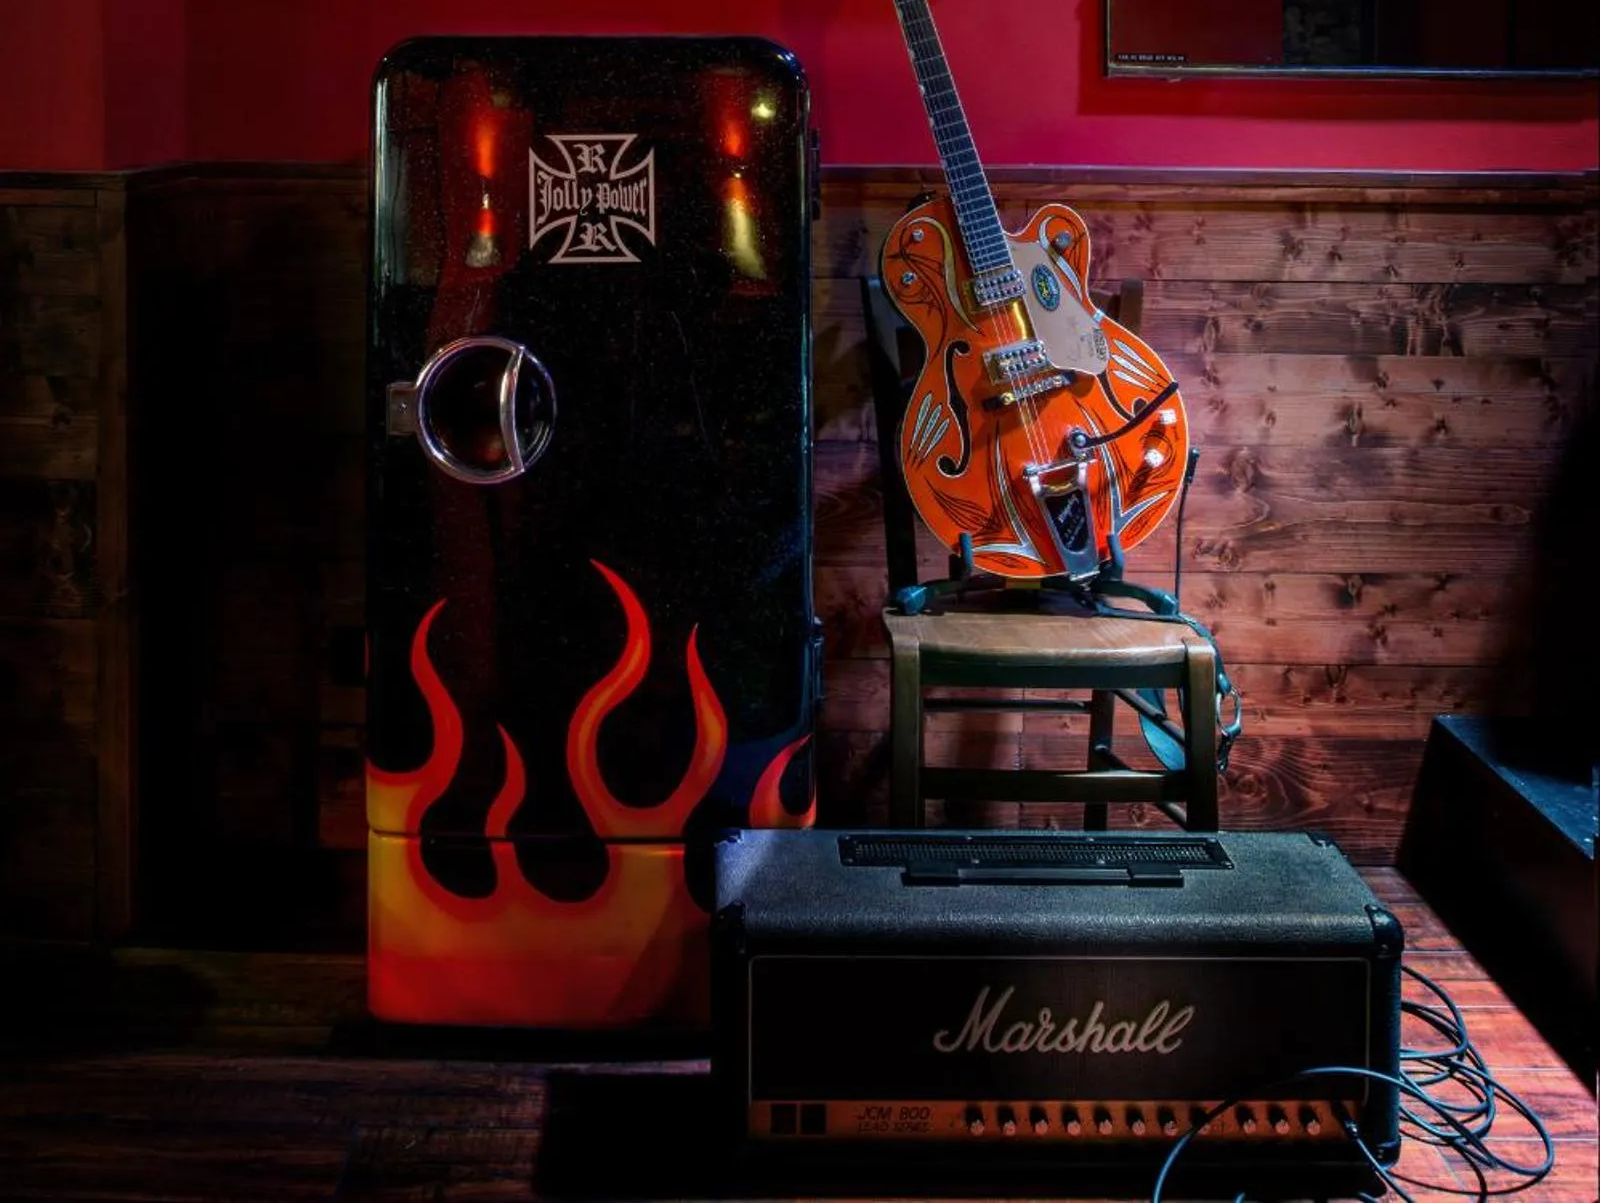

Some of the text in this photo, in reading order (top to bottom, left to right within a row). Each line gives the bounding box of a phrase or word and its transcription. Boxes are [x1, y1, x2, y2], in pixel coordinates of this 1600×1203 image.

[536, 169, 593, 226] Jolly
[932, 984, 1196, 1055] Marshall
[900, 1106, 930, 1120] 800
